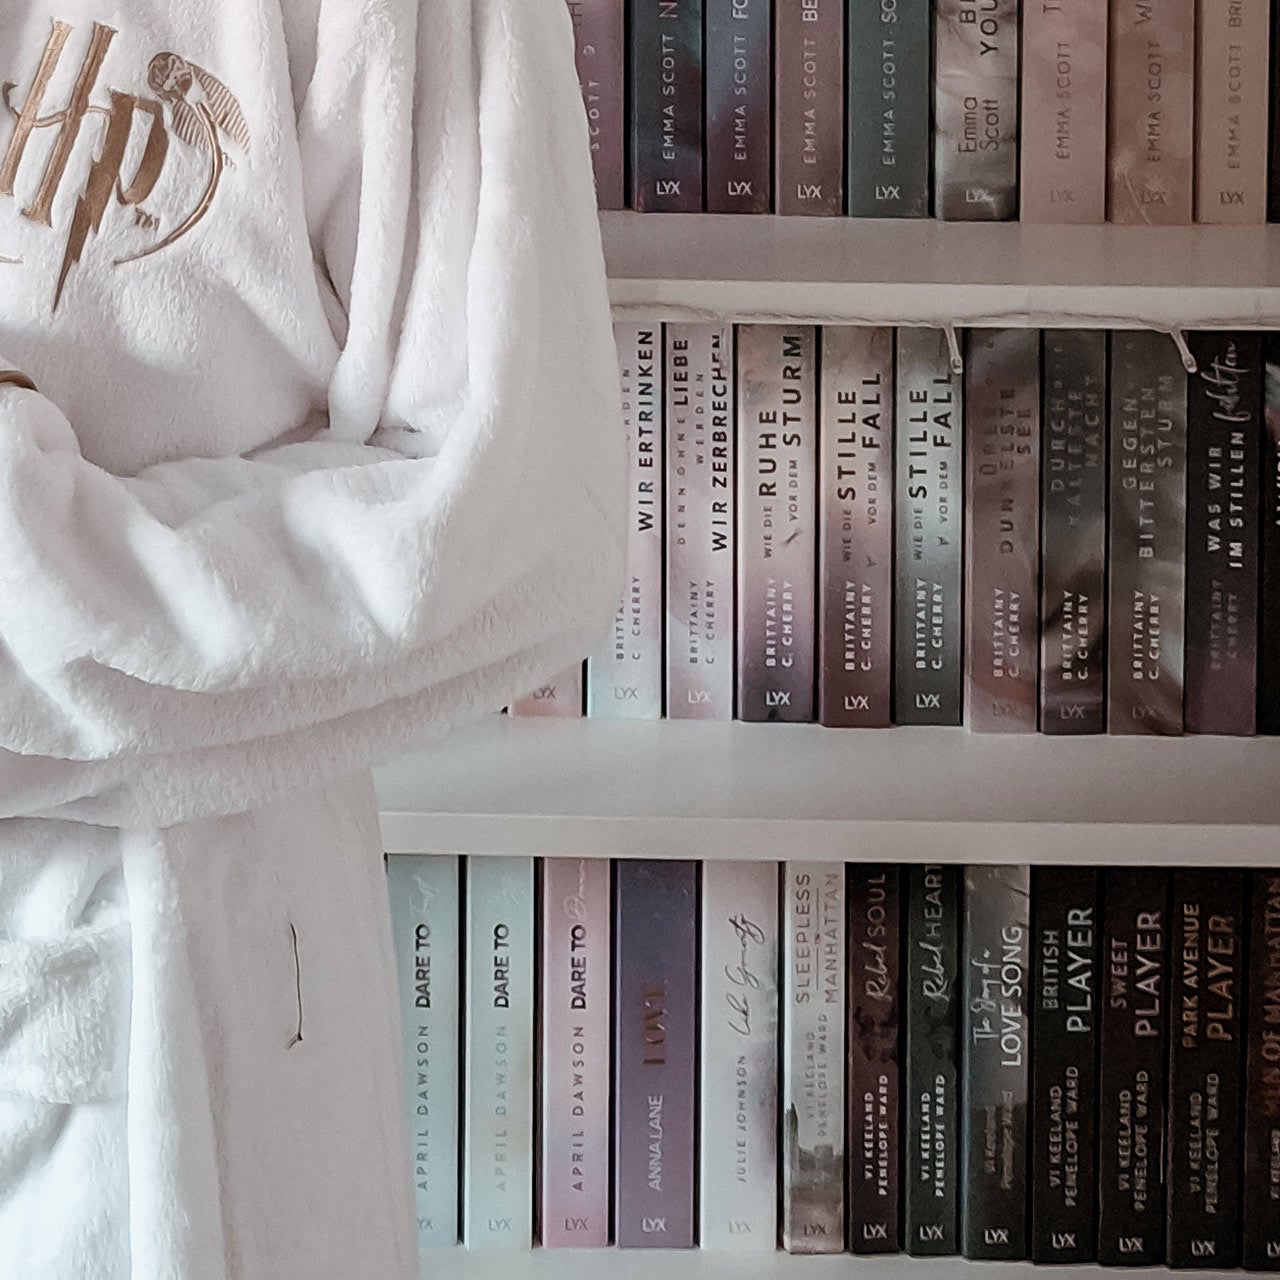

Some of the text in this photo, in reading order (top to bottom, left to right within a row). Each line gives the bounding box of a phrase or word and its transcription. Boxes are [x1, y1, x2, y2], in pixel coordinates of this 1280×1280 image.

[957, 97, 978, 153] Emma
[980, 98, 1000, 152] Scott
[673, 339, 688, 406] LIEBE
[783, 335, 802, 447] STURM
[862, 373, 881, 449] FALL
[639, 330, 653, 532] WIR ERTRINKEN
[758, 410, 777, 497] RUHE
[837, 391, 856, 500] STILLE
[571, 924, 586, 1010] DARE TO
[796, 874, 810, 1004] SLEEPLESS
[1042, 929, 1059, 1010] BRITISH
[1067, 906, 1093, 1032] PLAYER
[1111, 937, 1129, 1010] SWEET
[1135, 911, 1162, 1037] PLAYER
[1001, 925, 1023, 1067] LOVE SONG
[416, 924, 431, 1191] APRIL DAWSON DARE TO
